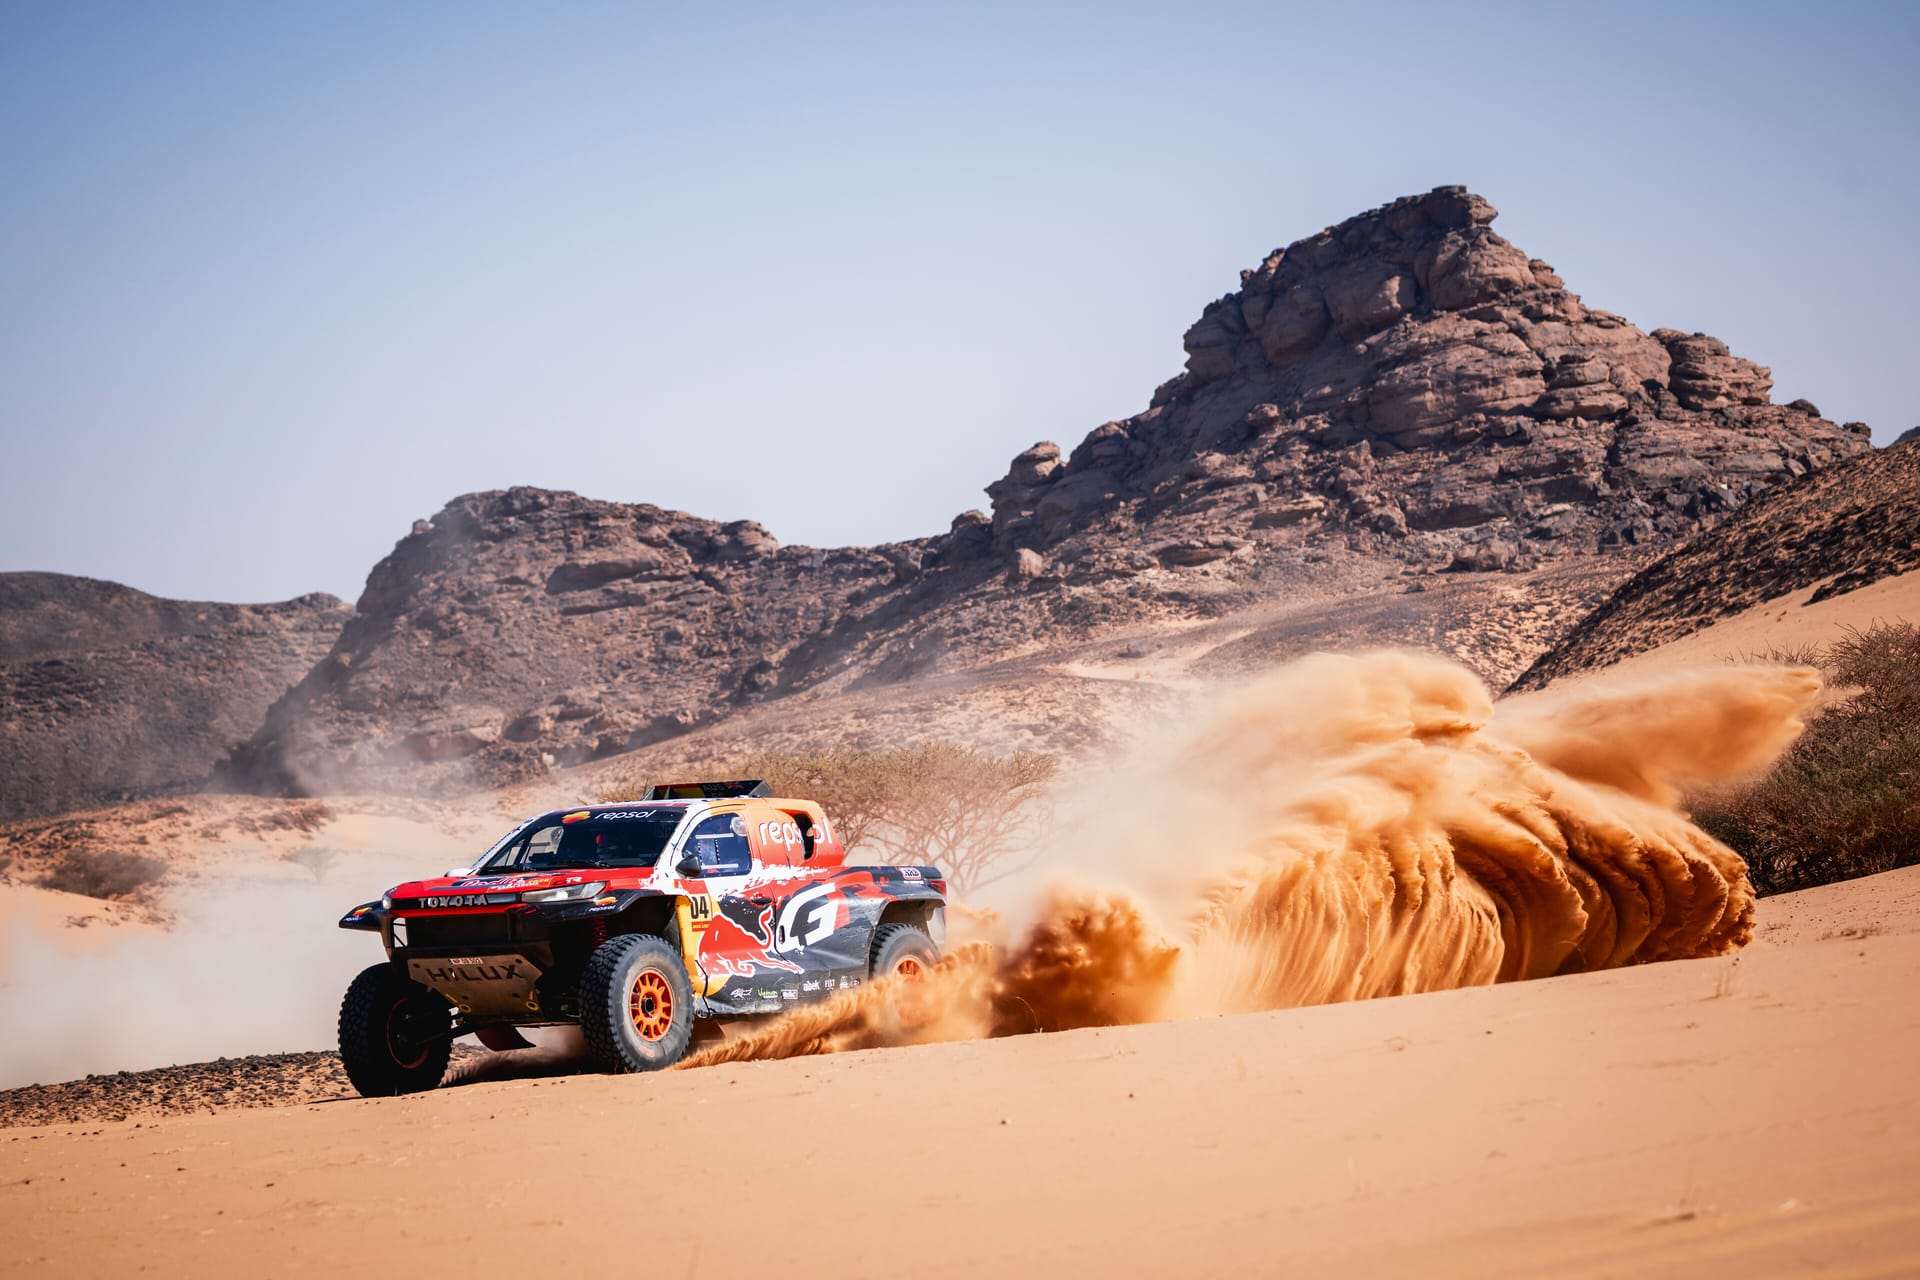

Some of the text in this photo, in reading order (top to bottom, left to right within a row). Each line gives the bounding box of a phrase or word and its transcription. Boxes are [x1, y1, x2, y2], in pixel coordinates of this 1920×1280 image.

[595, 809, 657, 820] repsol
[418, 894, 488, 909] TOYOTA
[588, 904, 616, 913] repsol
[690, 895, 709, 919] 04
[425, 964, 527, 982] HILUX
